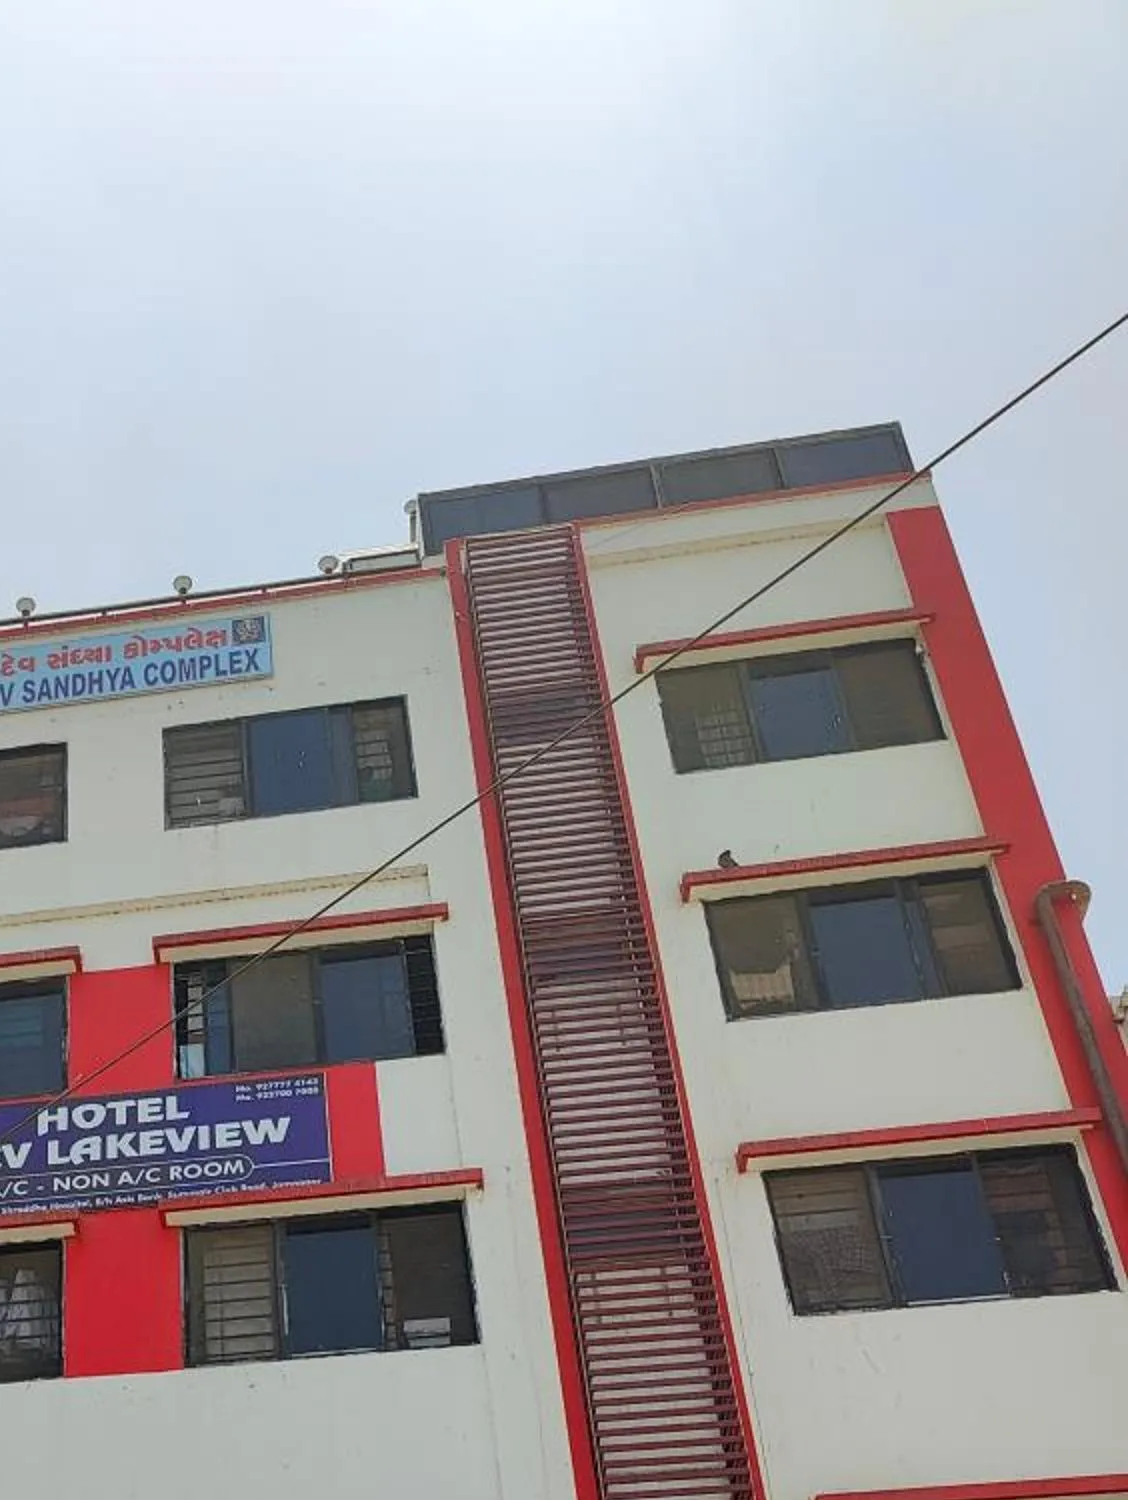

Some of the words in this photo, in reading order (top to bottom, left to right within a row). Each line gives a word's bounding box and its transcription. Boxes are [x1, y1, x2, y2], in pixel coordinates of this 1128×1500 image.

[22, 667, 137, 704] SANDHYA
[143, 648, 260, 688] COMPLEX
[37, 1095, 191, 1137] HOTEL
[47, 1116, 291, 1165] LAKEVIEW
[53, 1172, 111, 1192] NON
[117, 1167, 161, 1186] A/C
[169, 1159, 245, 1181] ROOM
